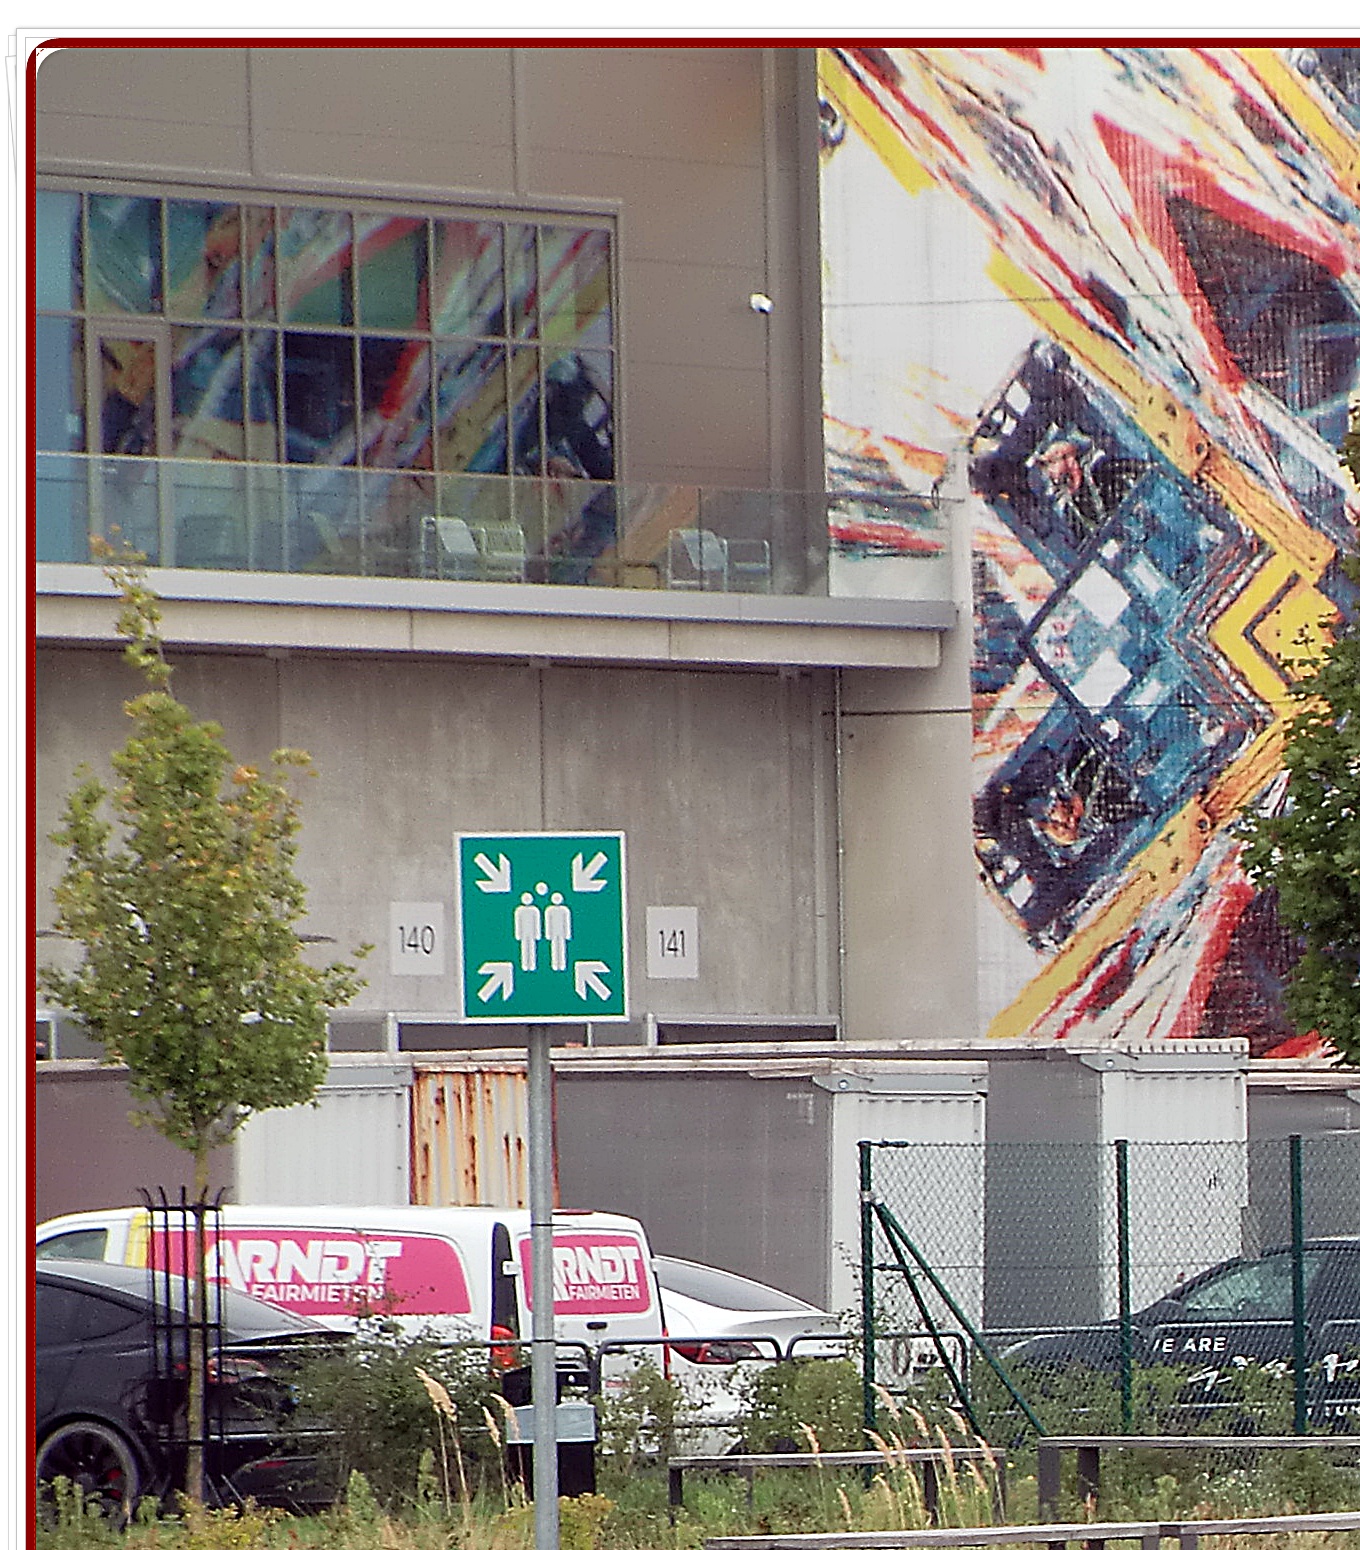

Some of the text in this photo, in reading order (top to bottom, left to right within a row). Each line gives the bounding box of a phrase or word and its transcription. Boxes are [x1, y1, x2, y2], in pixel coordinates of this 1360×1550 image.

[399, 925, 436, 955] 140
[659, 929, 686, 958] 141
[204, 1239, 403, 1294] ARNDT
[568, 1283, 640, 1300] FAIRMIETEN
[1182, 1336, 1227, 1352] ARE
